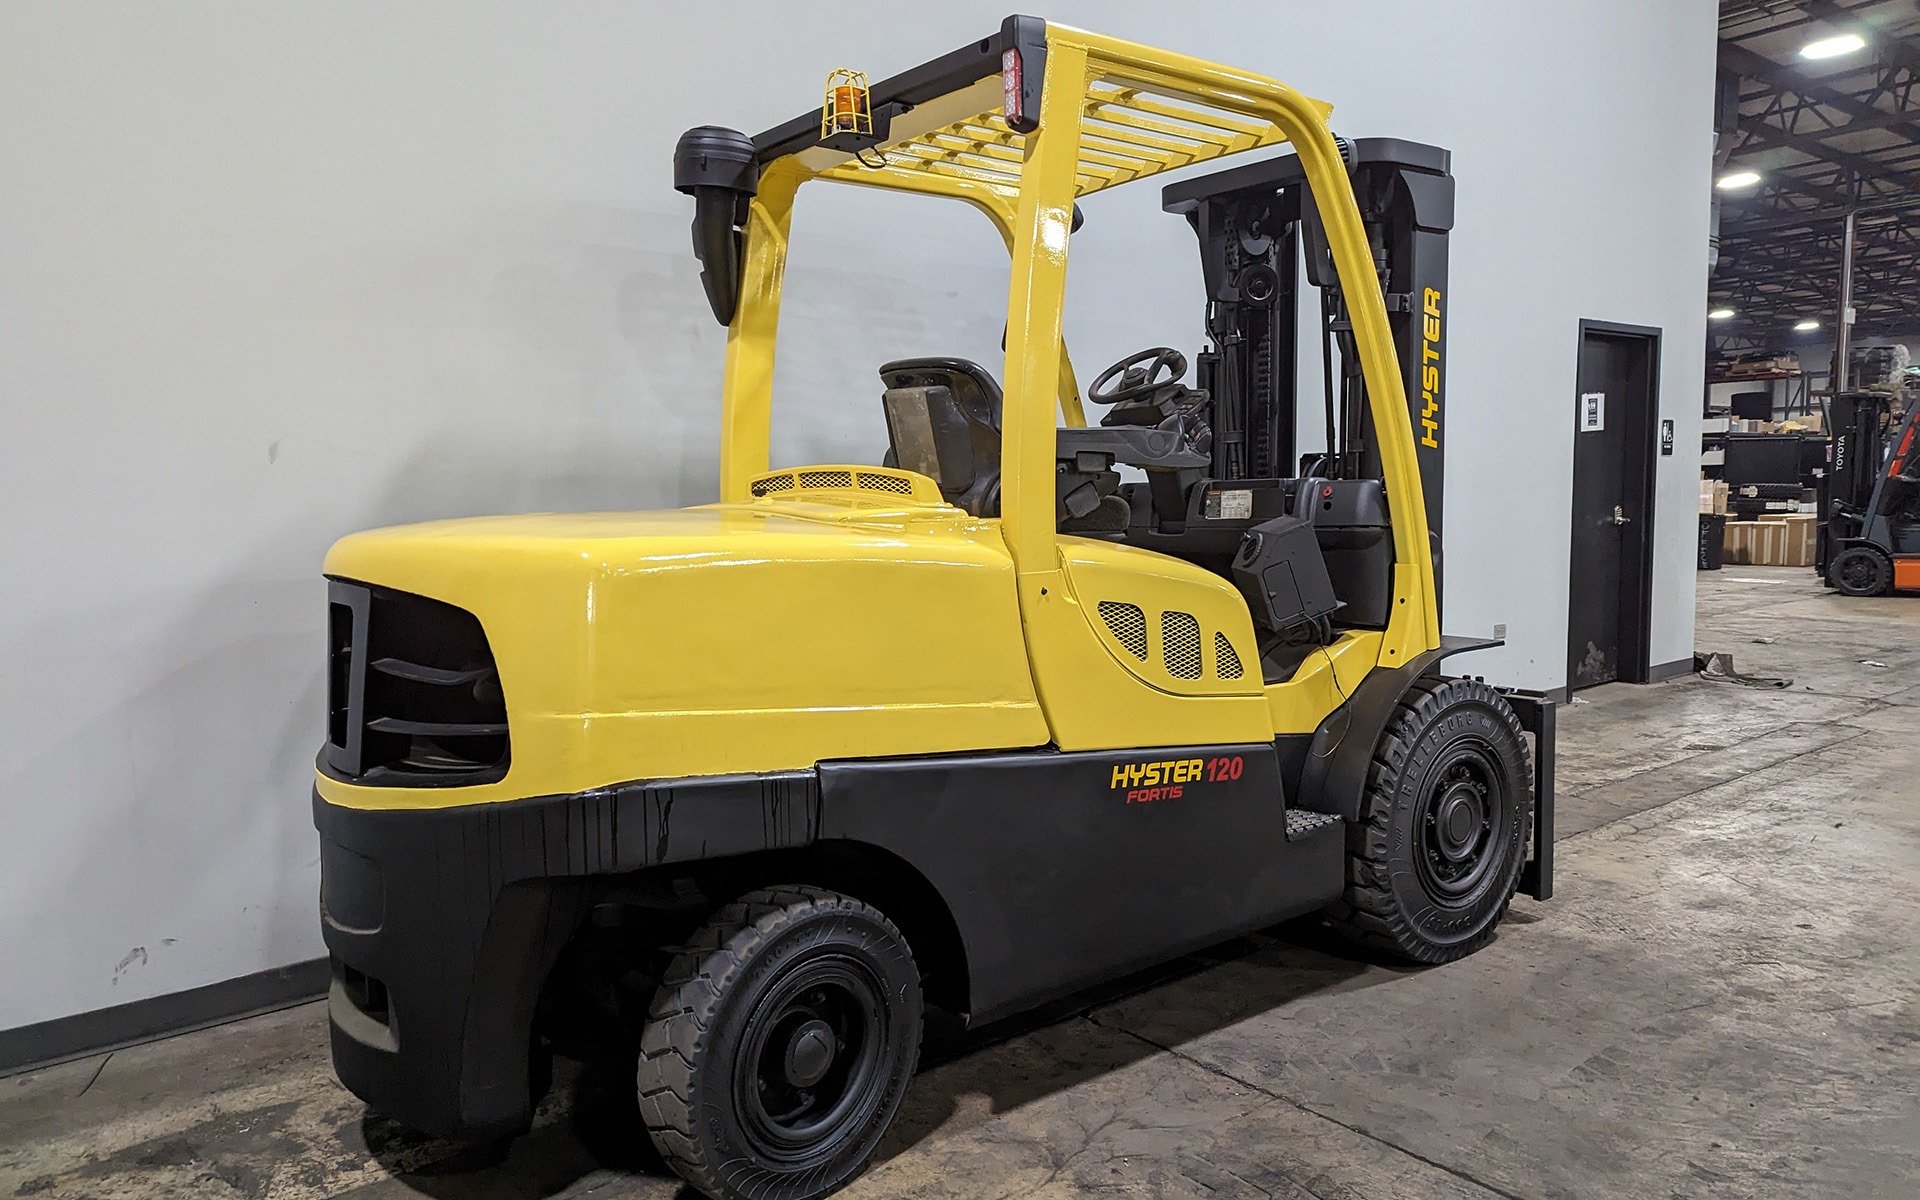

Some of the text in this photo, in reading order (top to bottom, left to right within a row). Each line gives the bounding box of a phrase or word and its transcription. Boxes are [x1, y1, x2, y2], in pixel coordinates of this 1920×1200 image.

[1421, 287, 1441, 449] HYSTER
[1835, 435, 1846, 471] TOYOTA
[1110, 756, 1244, 789] HYSTER 120
[1126, 785, 1184, 804] FORTIS
